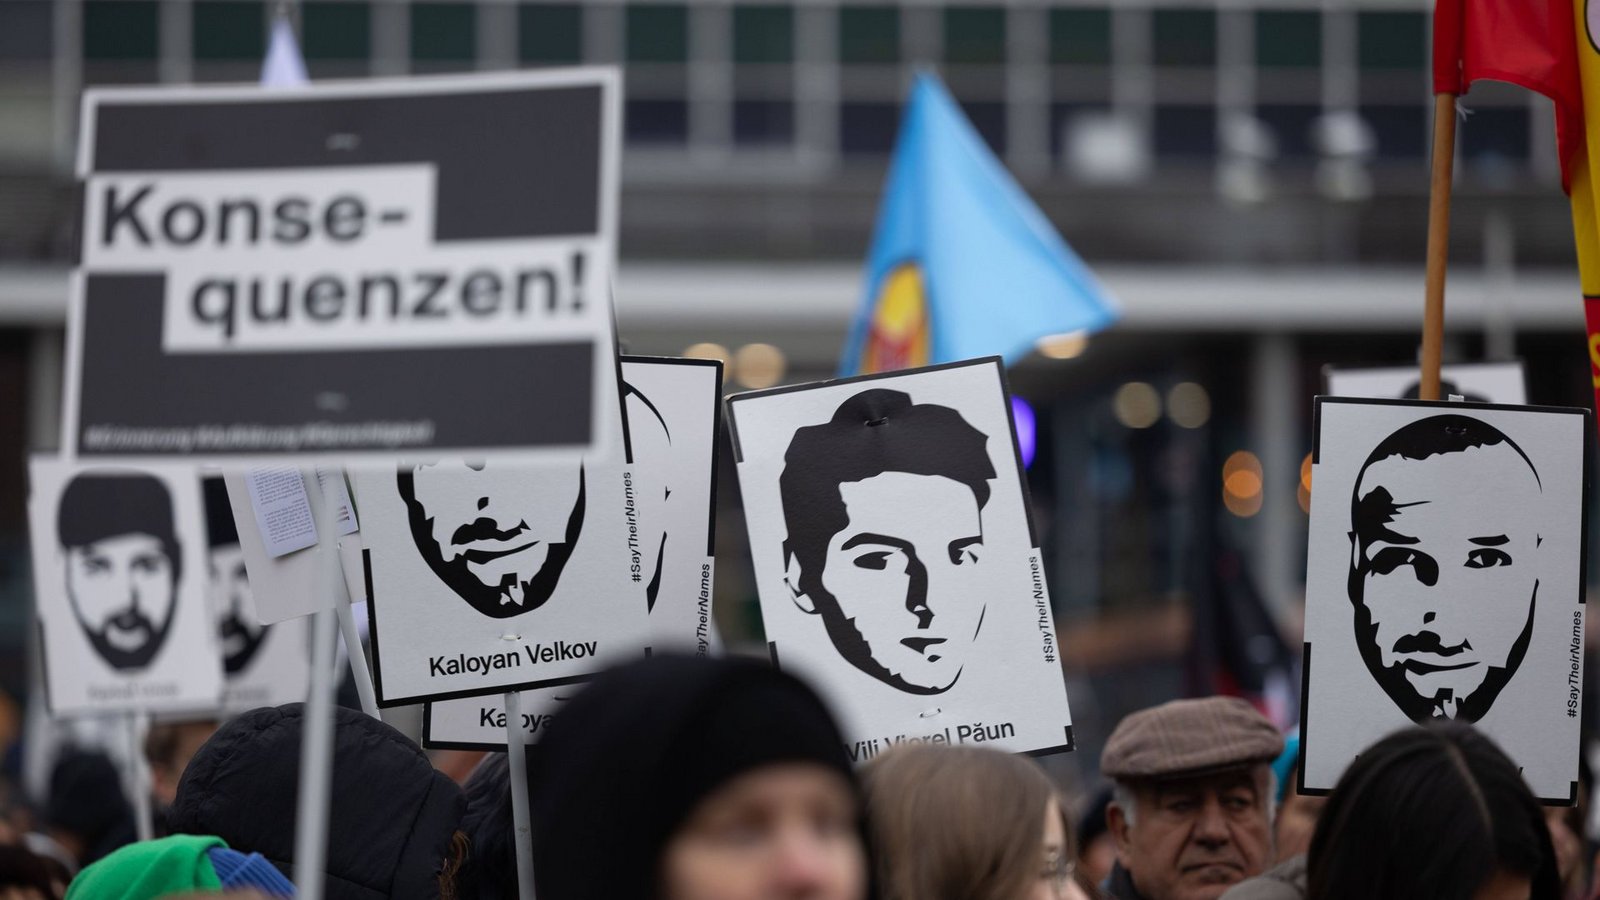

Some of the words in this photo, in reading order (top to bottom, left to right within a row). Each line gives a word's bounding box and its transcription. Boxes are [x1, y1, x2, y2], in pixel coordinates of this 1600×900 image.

[101, 181, 408, 247] Konse-
[190, 250, 588, 340] quenzen!
[624, 472, 642, 583] #SayTheirNames
[696, 564, 710, 656] ayTheirNames
[1029, 556, 1055, 663] #SayTheirNames
[429, 651, 520, 677] Kaloyan
[525, 641, 597, 664] Velkov
[1567, 611, 1582, 718] #SayTheirNames
[480, 708, 553, 733] Kaoya
[844, 739, 879, 762] Vili
[957, 722, 1015, 745] Păun
